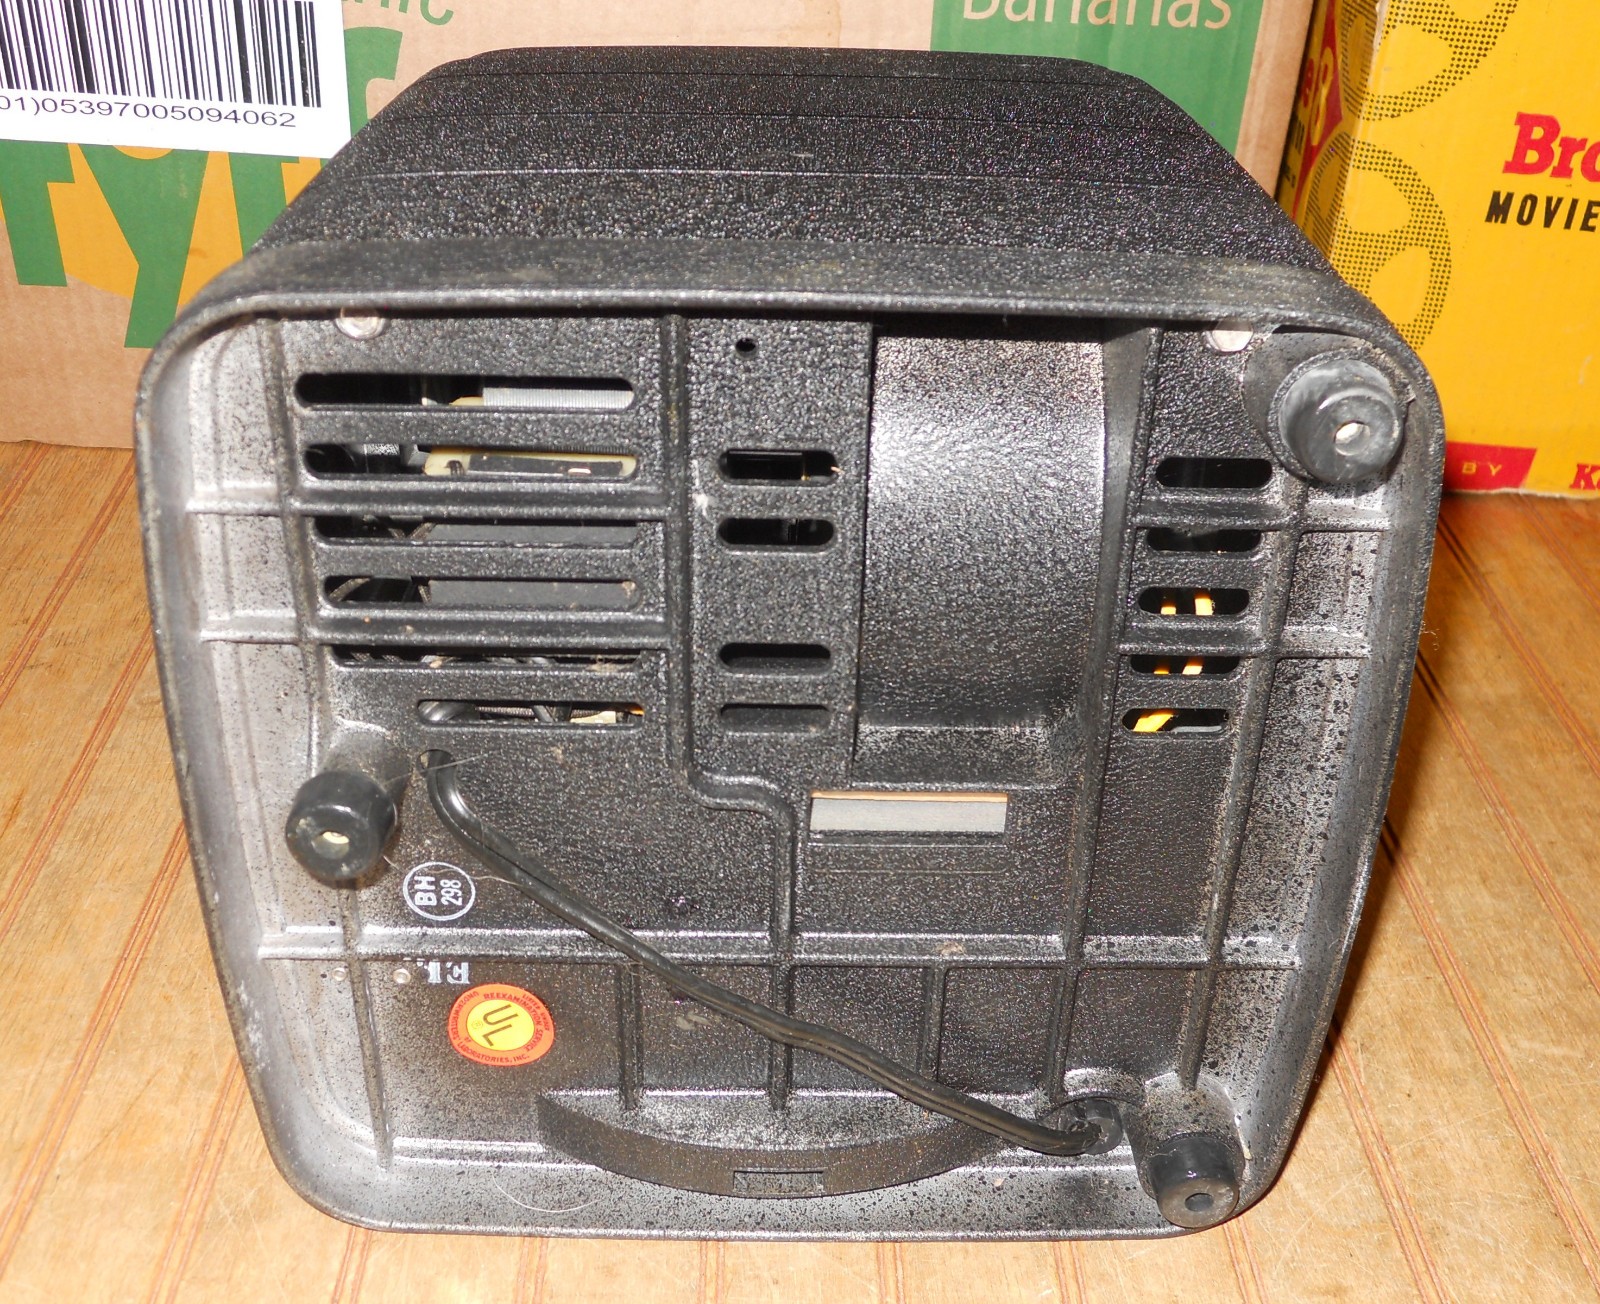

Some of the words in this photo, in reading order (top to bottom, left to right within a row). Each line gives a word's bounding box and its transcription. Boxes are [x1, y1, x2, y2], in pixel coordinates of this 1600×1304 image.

[1484, 190, 1600, 232] MOVIE
[1461, 461, 1503, 477] BY
[414, 875, 437, 906] BH
[440, 878, 463, 906] 298
[482, 1003, 519, 1047] UL
[483, 992, 541, 1026] REEXAMINATION
[524, 1027, 544, 1052] SERVICE
